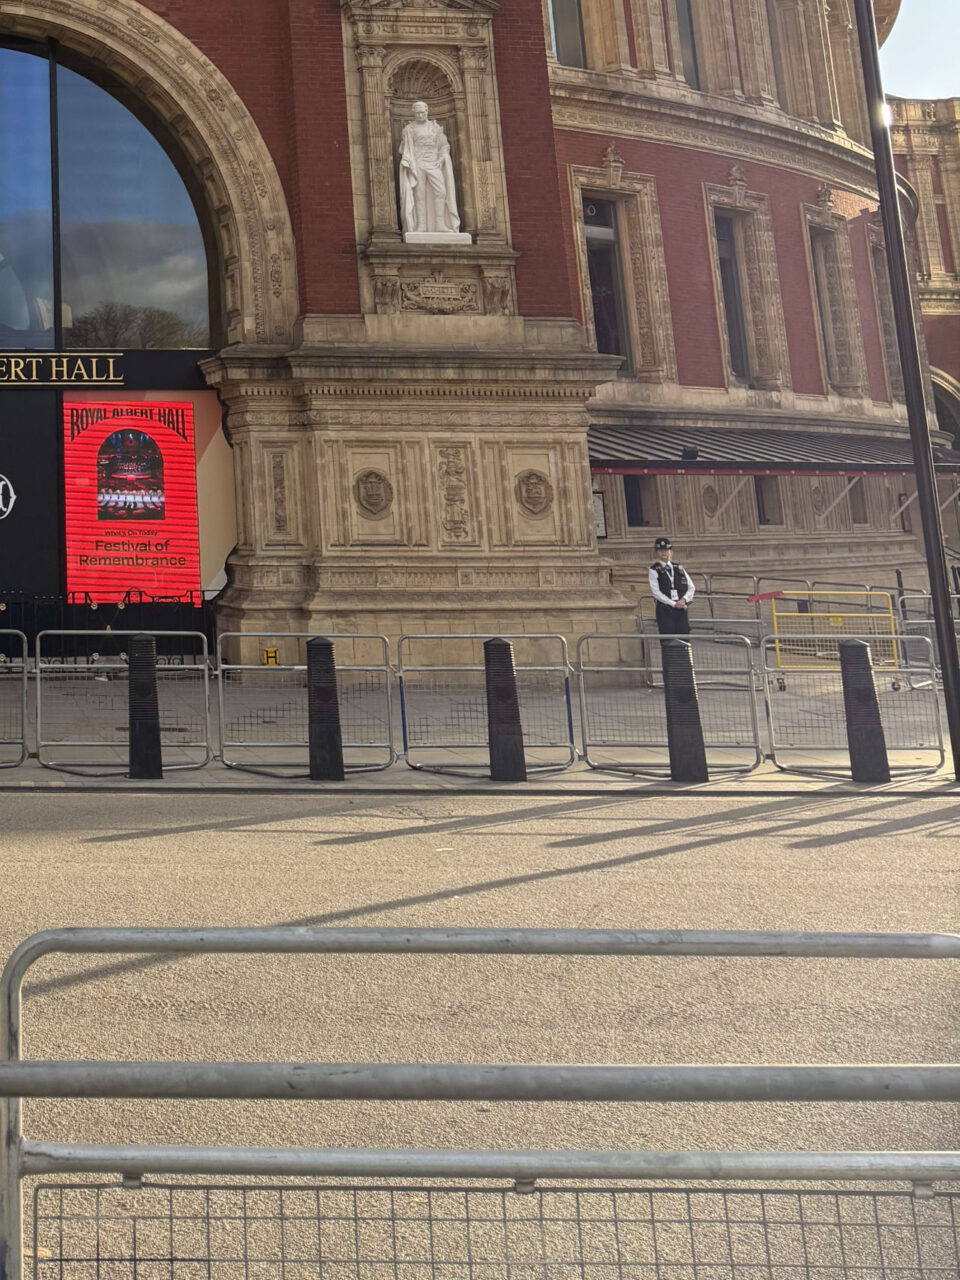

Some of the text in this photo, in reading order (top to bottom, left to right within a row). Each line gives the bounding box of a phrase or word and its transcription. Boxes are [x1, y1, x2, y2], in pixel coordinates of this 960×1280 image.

[49, 358, 124, 381] HALL
[70, 407, 188, 442] ROYAL ALBERT HALL
[95, 540, 170, 552] Festival of
[79, 555, 186, 567] Remembrance
[266, 650, 278, 664] H
